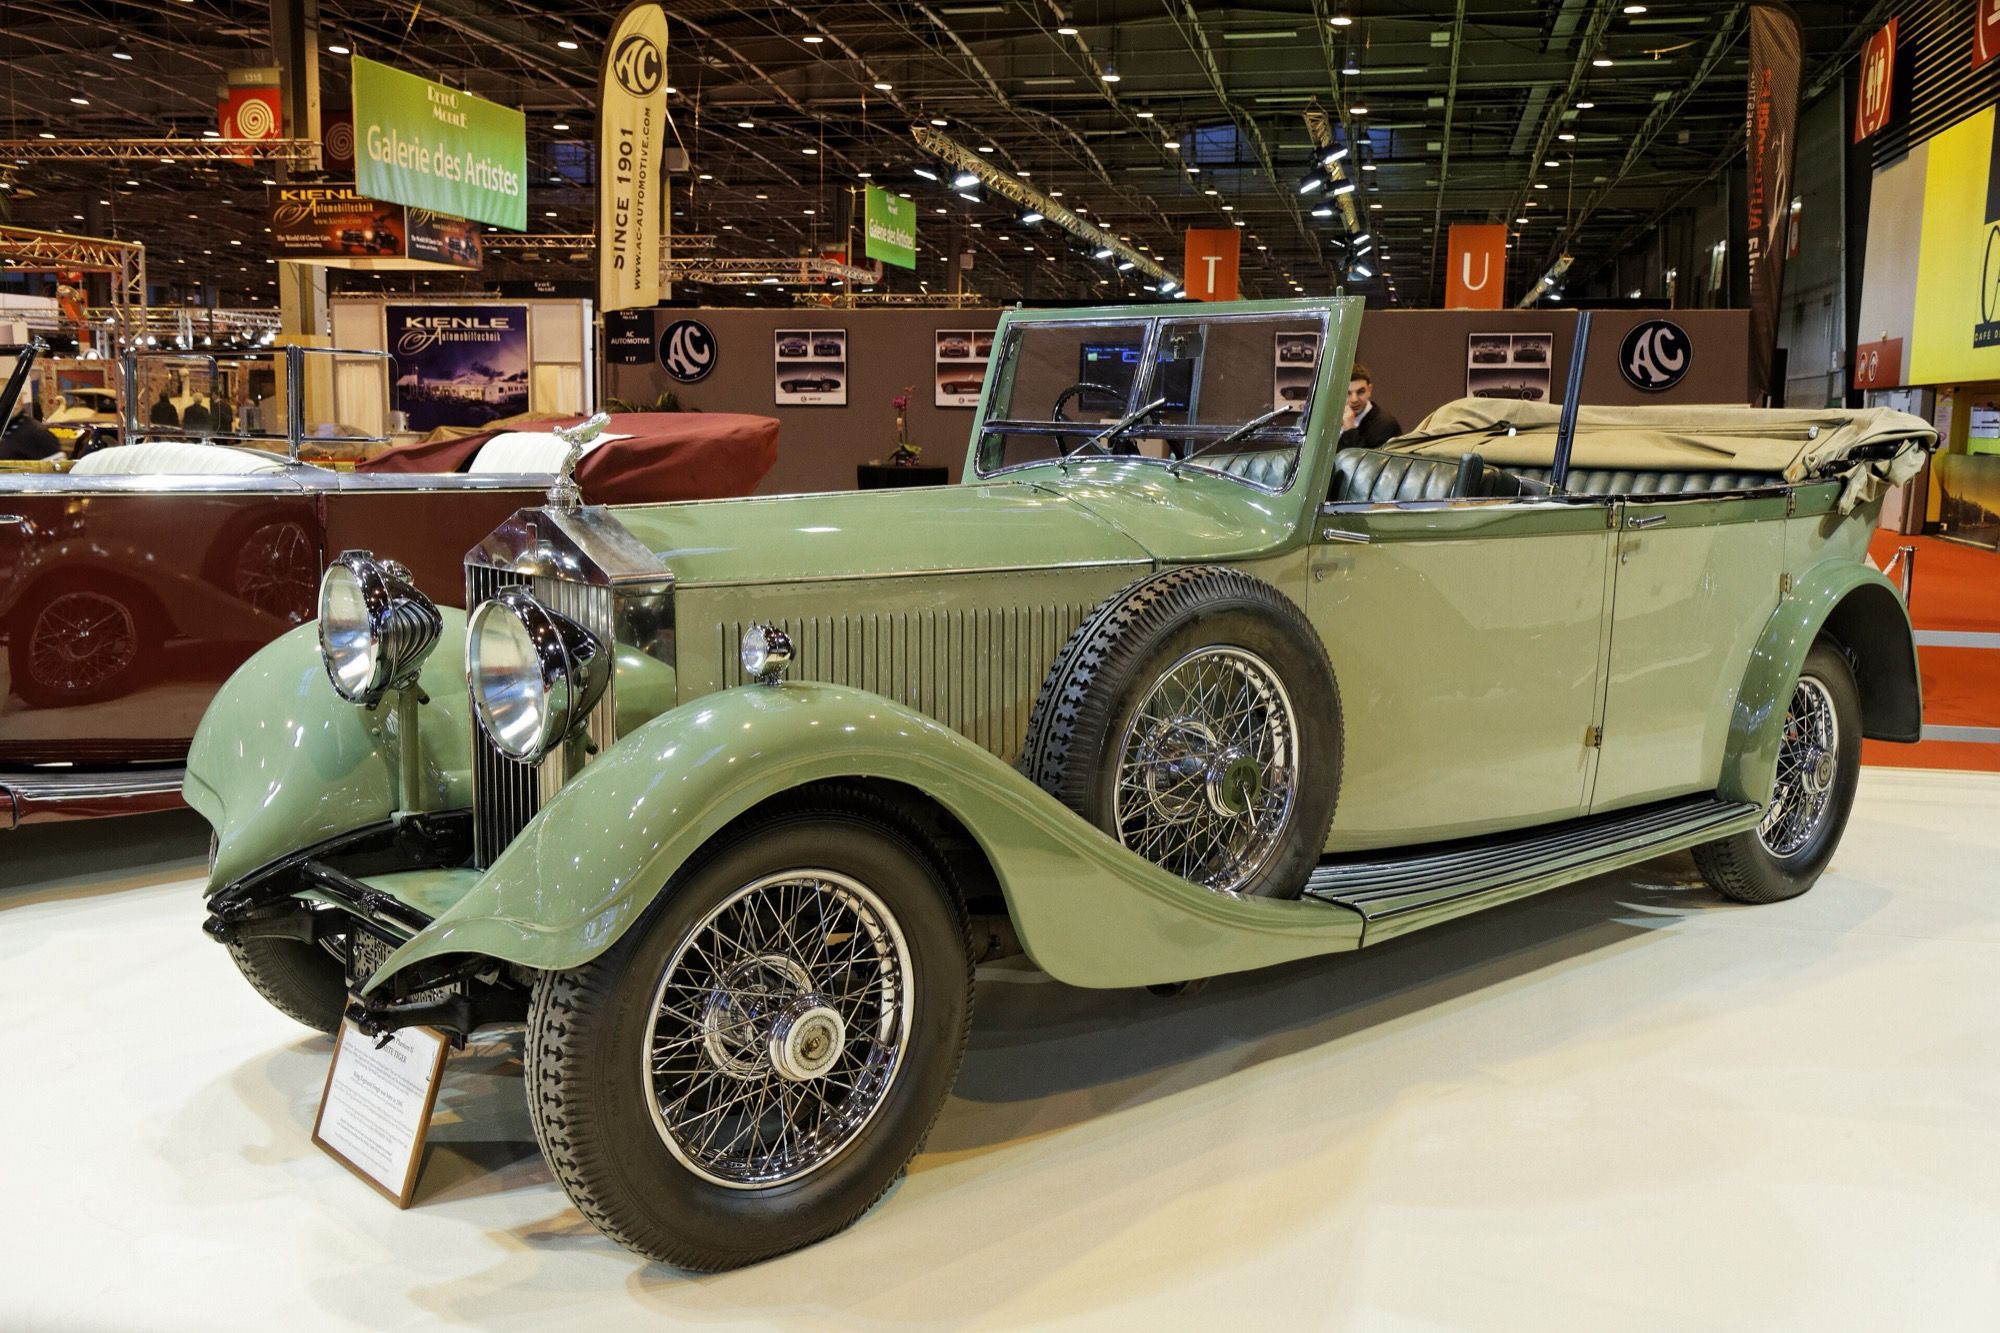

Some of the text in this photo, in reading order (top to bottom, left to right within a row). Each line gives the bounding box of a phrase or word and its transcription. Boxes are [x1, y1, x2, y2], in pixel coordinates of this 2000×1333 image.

[615, 40, 658, 93] AC
[367, 124, 519, 197] Galerie des Artistes
[281, 189, 366, 201] KIENL
[613, 128, 634, 270] SINCE 1901
[1202, 256, 1222, 294] T
[1463, 252, 1489, 291] U
[398, 326, 501, 355] Automobiltechnik
[405, 317, 509, 329] KIENLE
[610, 337, 650, 345] AUTOMOTIVE
[666, 326, 711, 376] AC
[1629, 327, 1684, 383] AC
